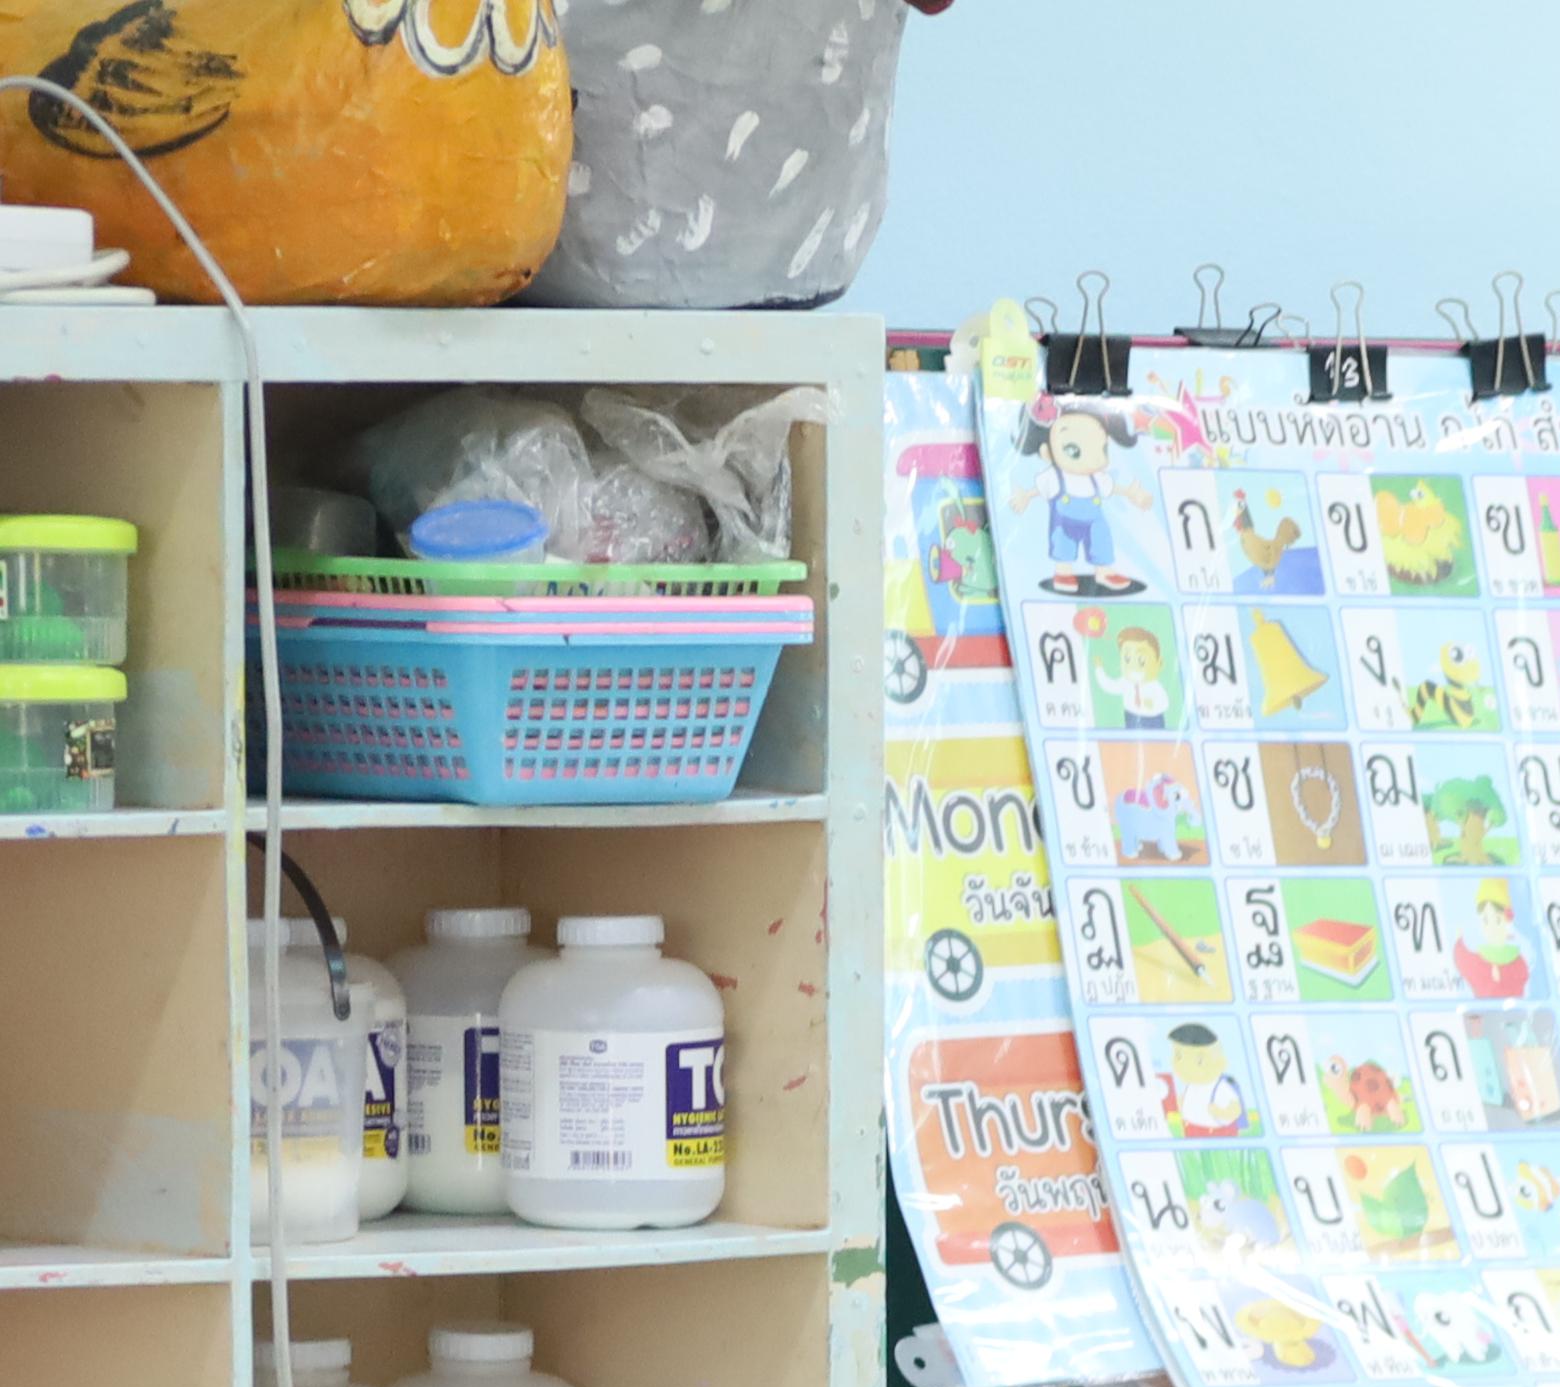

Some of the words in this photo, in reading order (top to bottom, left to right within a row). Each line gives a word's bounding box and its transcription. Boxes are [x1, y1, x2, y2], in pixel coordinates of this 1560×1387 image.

[1177, 498, 1216, 551] ก
[1327, 500, 1369, 554] ข
[1038, 629, 1078, 686] ฅ
[1193, 631, 1239, 687] ฆ
[1360, 633, 1389, 688] ง
[1506, 635, 1545, 690] จ
[1054, 754, 1097, 812] ช
[1212, 755, 1256, 812] ซ
[1365, 752, 1421, 808] ฌ
[1079, 886, 1126, 972] ฏ
[1244, 882, 1286, 972] ฐ
[1393, 900, 1444, 955] ฑ
[1102, 1034, 1147, 1090] ด
[1264, 1031, 1308, 1087] ต
[1422, 1028, 1465, 1084] ถ
[1130, 1179, 1190, 1233] น
[1292, 1174, 1345, 1227] บ
[1453, 1150, 1506, 1222] ป
